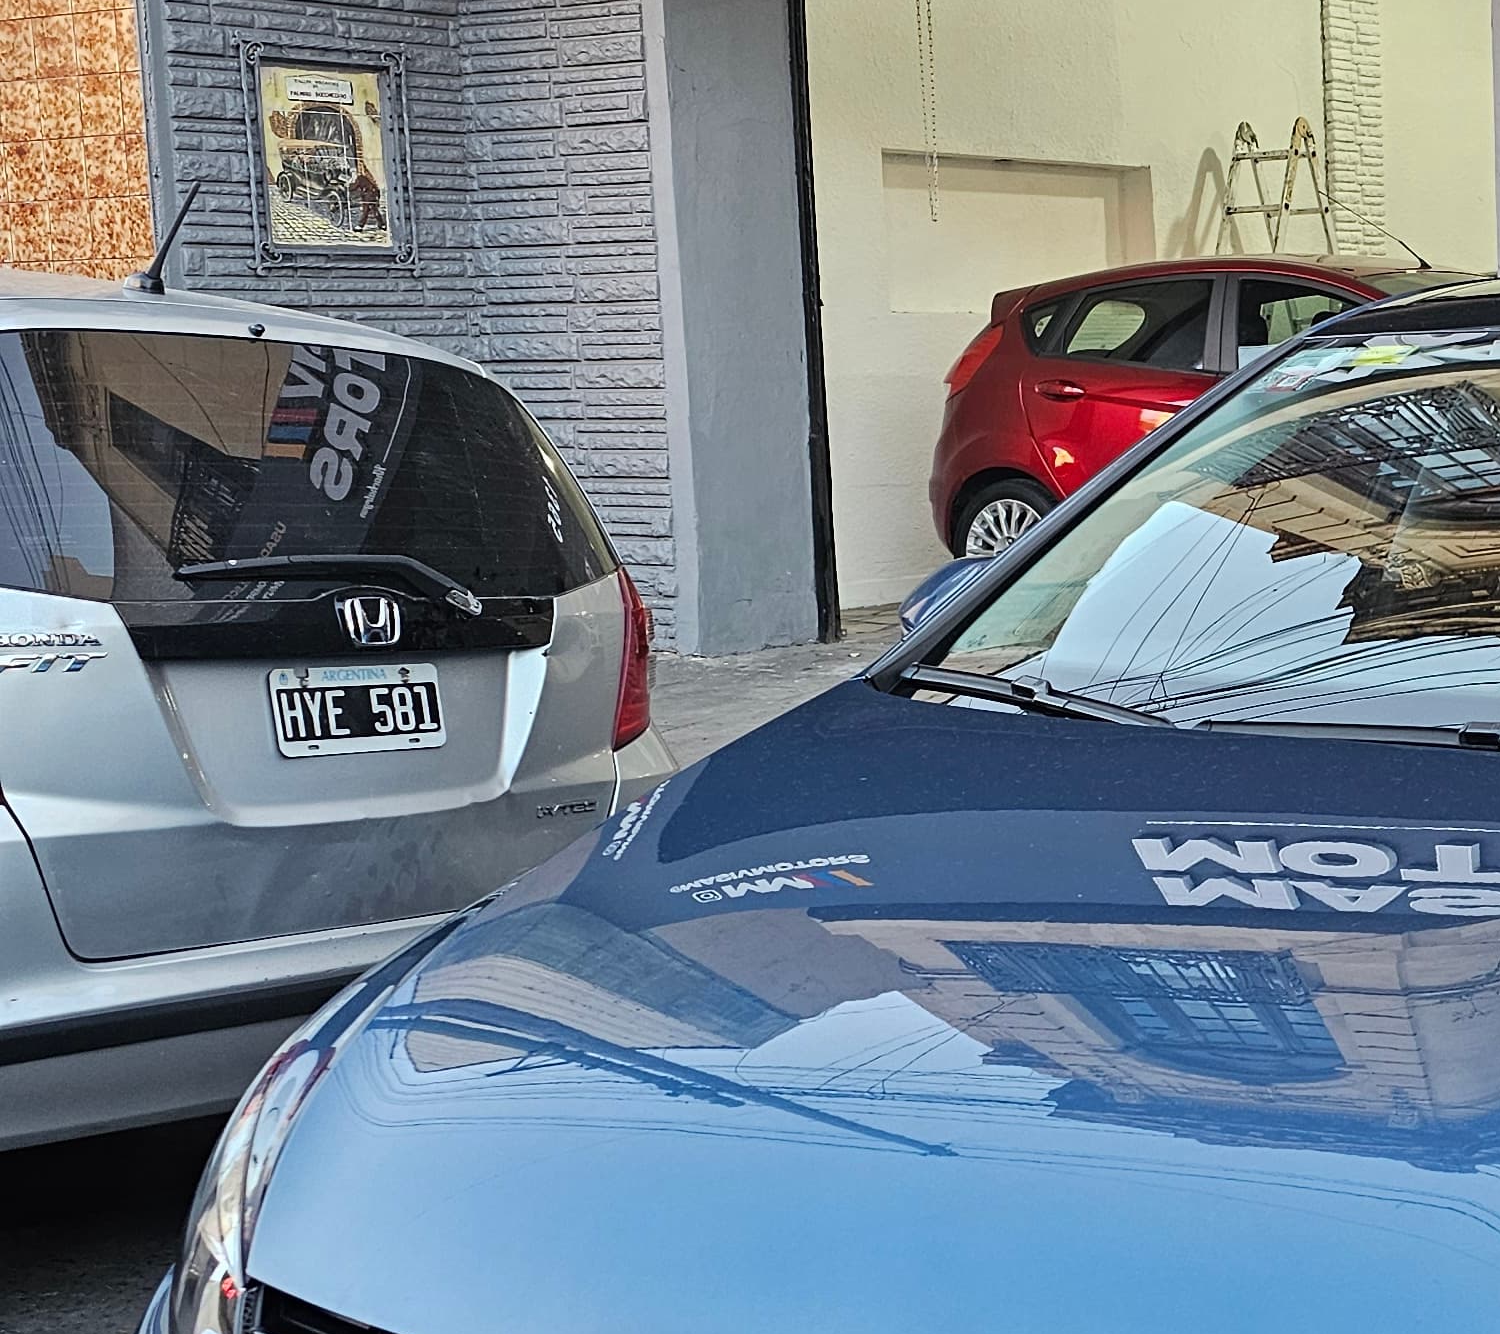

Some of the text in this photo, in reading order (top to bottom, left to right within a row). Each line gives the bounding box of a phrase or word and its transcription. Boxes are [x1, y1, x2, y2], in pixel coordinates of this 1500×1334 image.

[0, 652, 108, 673] FIT
[322, 668, 387, 682] ARGENTINA
[280, 686, 439, 739] HYE 581
